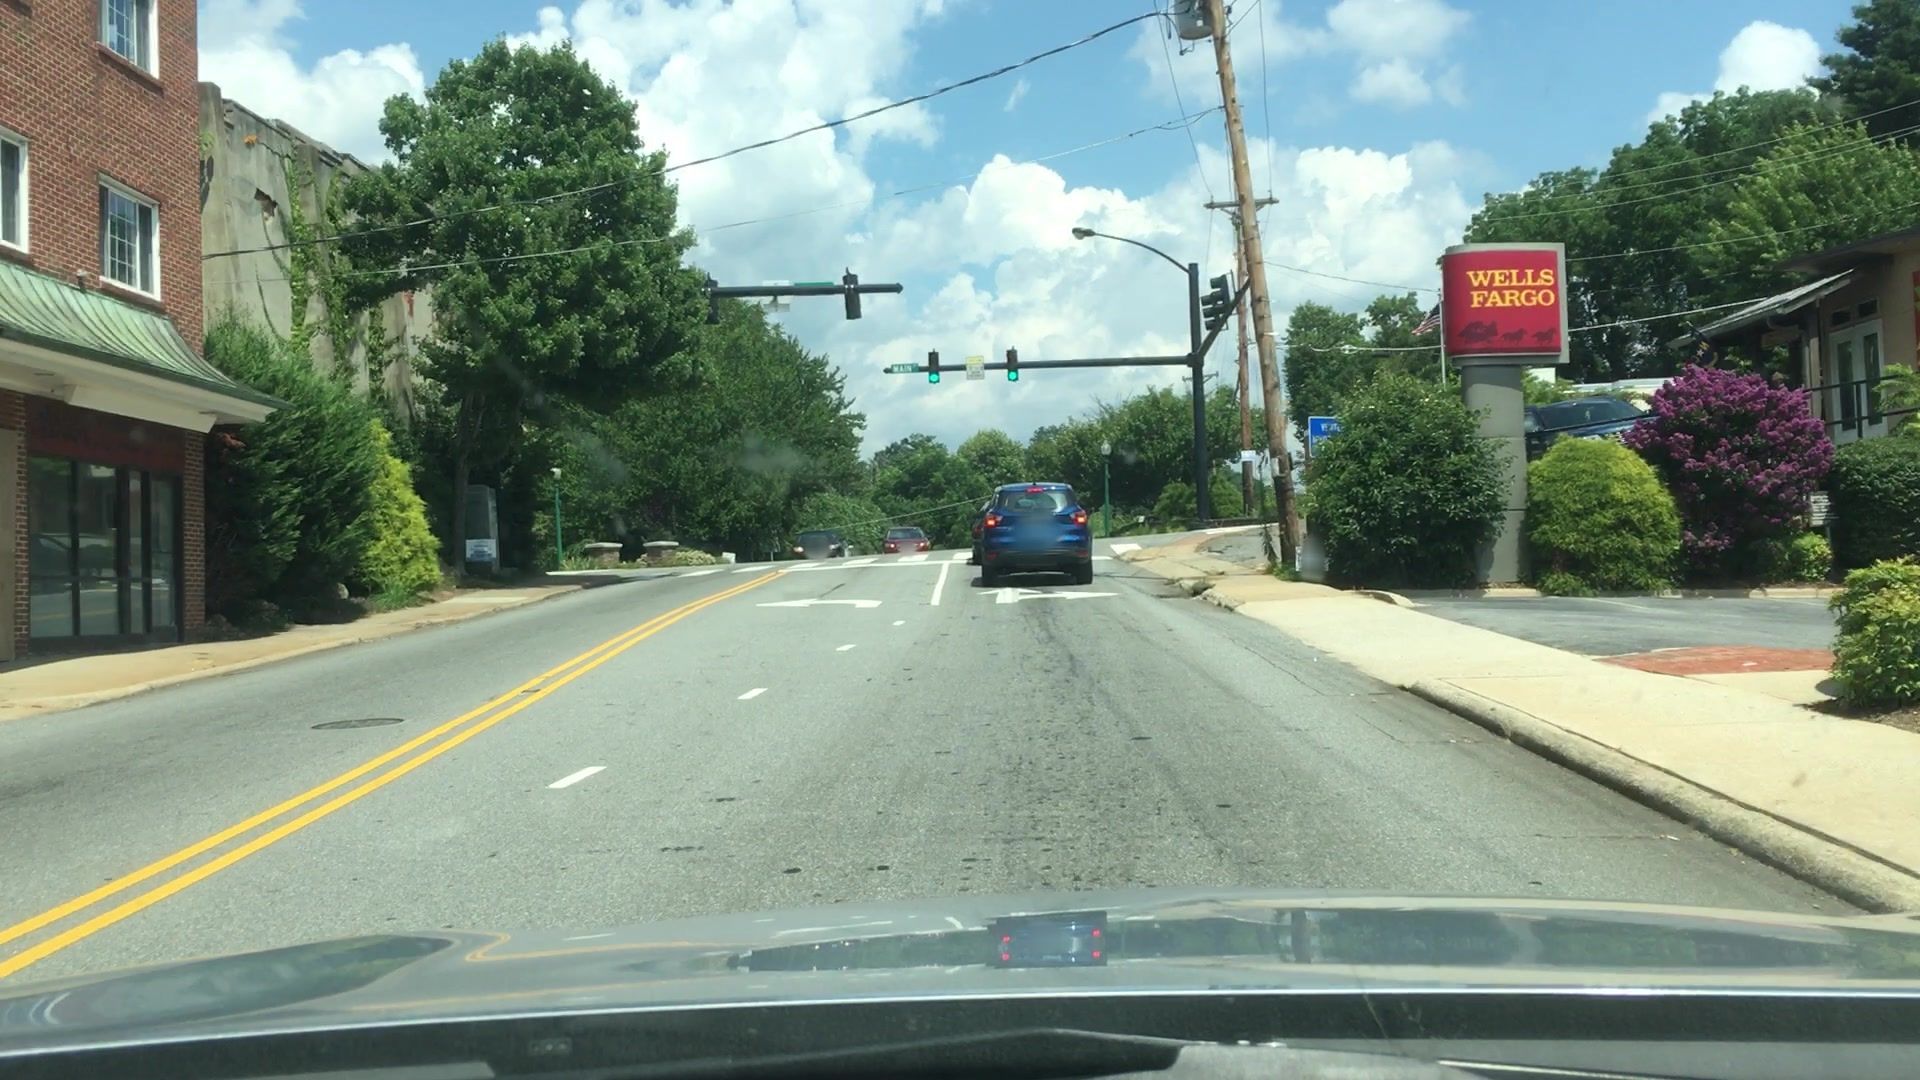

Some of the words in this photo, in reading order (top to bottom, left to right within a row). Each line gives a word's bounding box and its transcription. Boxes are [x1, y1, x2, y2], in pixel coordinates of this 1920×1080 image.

[1466, 269, 1555, 287] WELLS
[1470, 289, 1555, 308] FARGO
[892, 365, 912, 373] MAIN
